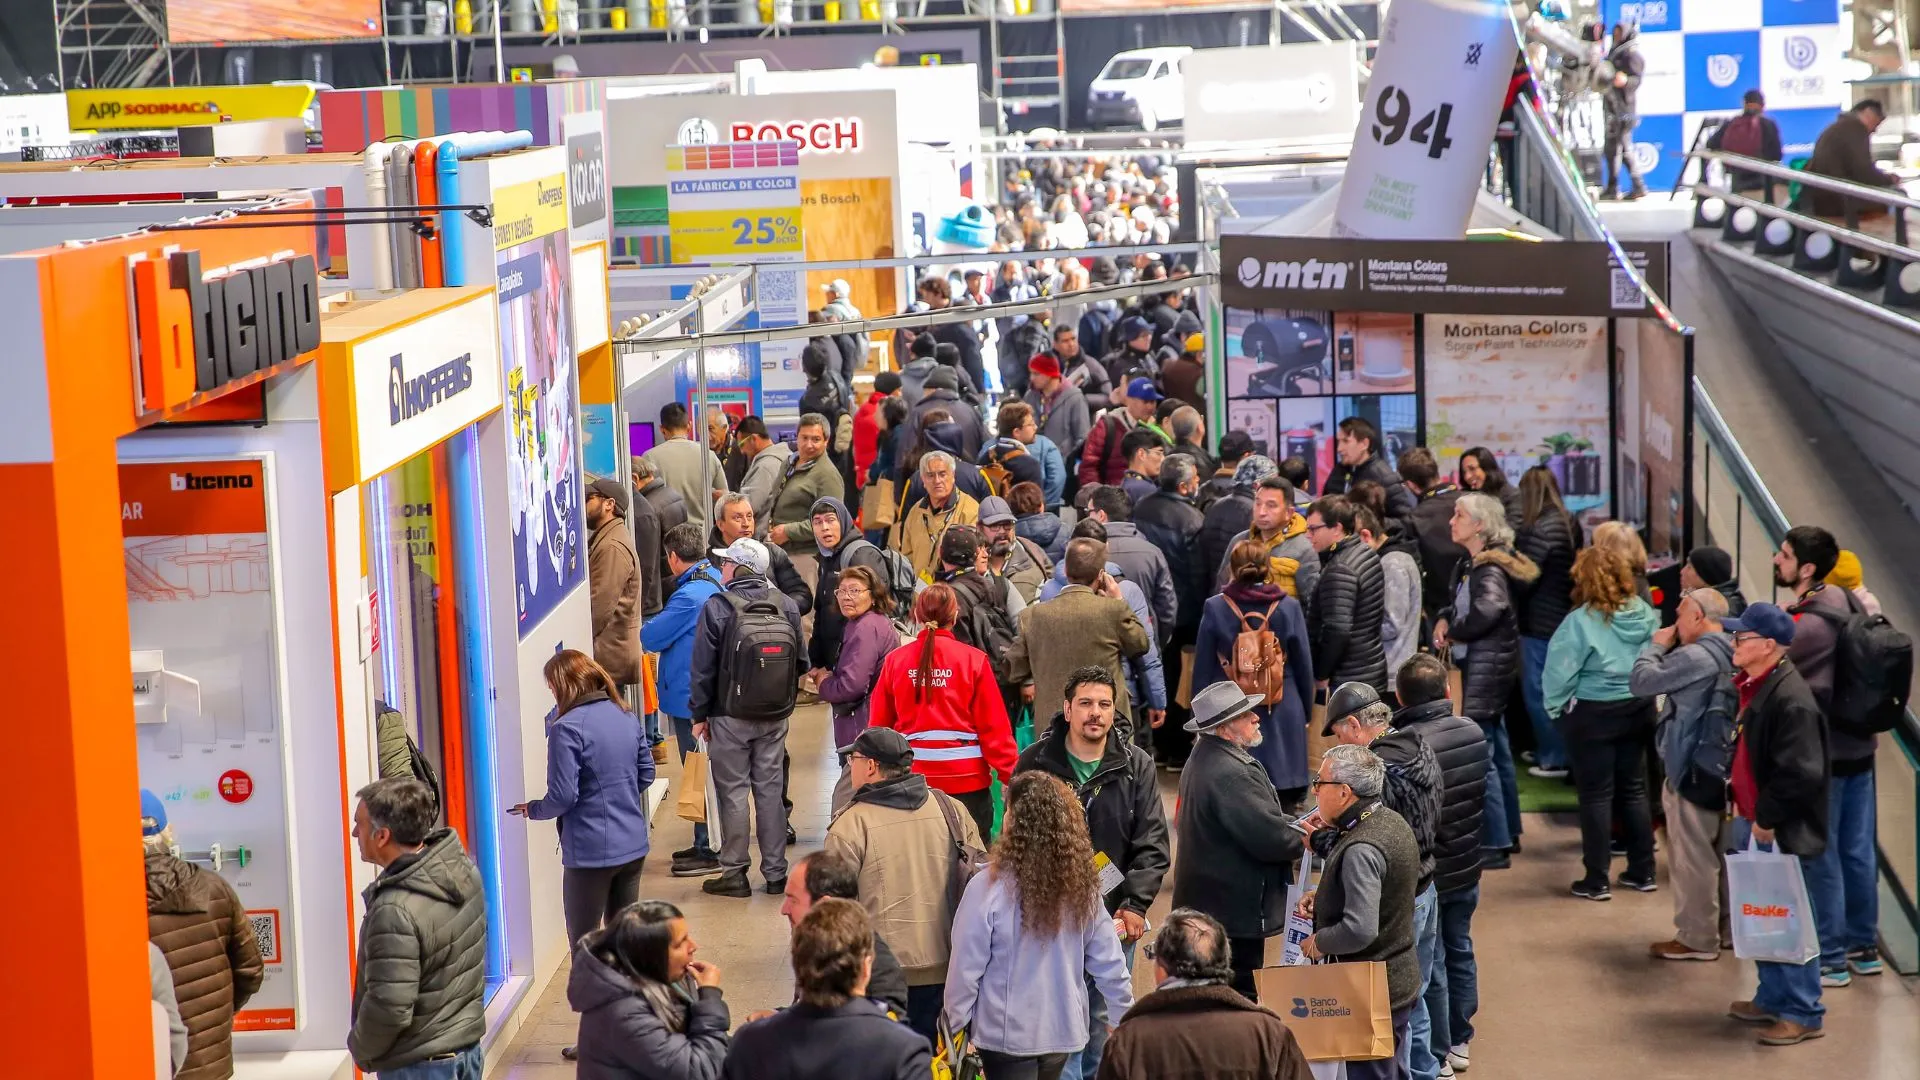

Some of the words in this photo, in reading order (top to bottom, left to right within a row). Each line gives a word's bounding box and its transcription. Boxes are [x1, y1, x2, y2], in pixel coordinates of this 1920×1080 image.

[86, 102, 121, 119] APP
[124, 103, 201, 115] SODIMAC
[1372, 85, 1453, 158] 94
[732, 122, 858, 150] BOSCH
[675, 183, 689, 192] LA
[739, 179, 753, 189] DE
[756, 178, 793, 188] COLOR
[820, 193, 861, 205] Bosch
[732, 216, 798, 245] 25%
[1368, 259, 1412, 271] Montana
[1413, 260, 1448, 272] Colors
[497, 269, 523, 296] Lavaplatos
[1369, 271, 1389, 281] Spray
[1389, 272, 1408, 281] Paint
[1409, 272, 1448, 283] Technology
[136, 249, 321, 410] bticino
[1444, 323, 1522, 337] Montana
[1528, 320, 1588, 335] Colors
[1445, 340, 1479, 353] Spray
[1484, 339, 1515, 350] Paint
[1520, 338, 1589, 350] Technology
[404, 352, 472, 420] HOFFENS
[170, 473, 254, 491] bticino
[1743, 904, 1789, 917] BauKer
[1310, 997, 1338, 1007] Banco
[1311, 1007, 1351, 1018] Falabella
